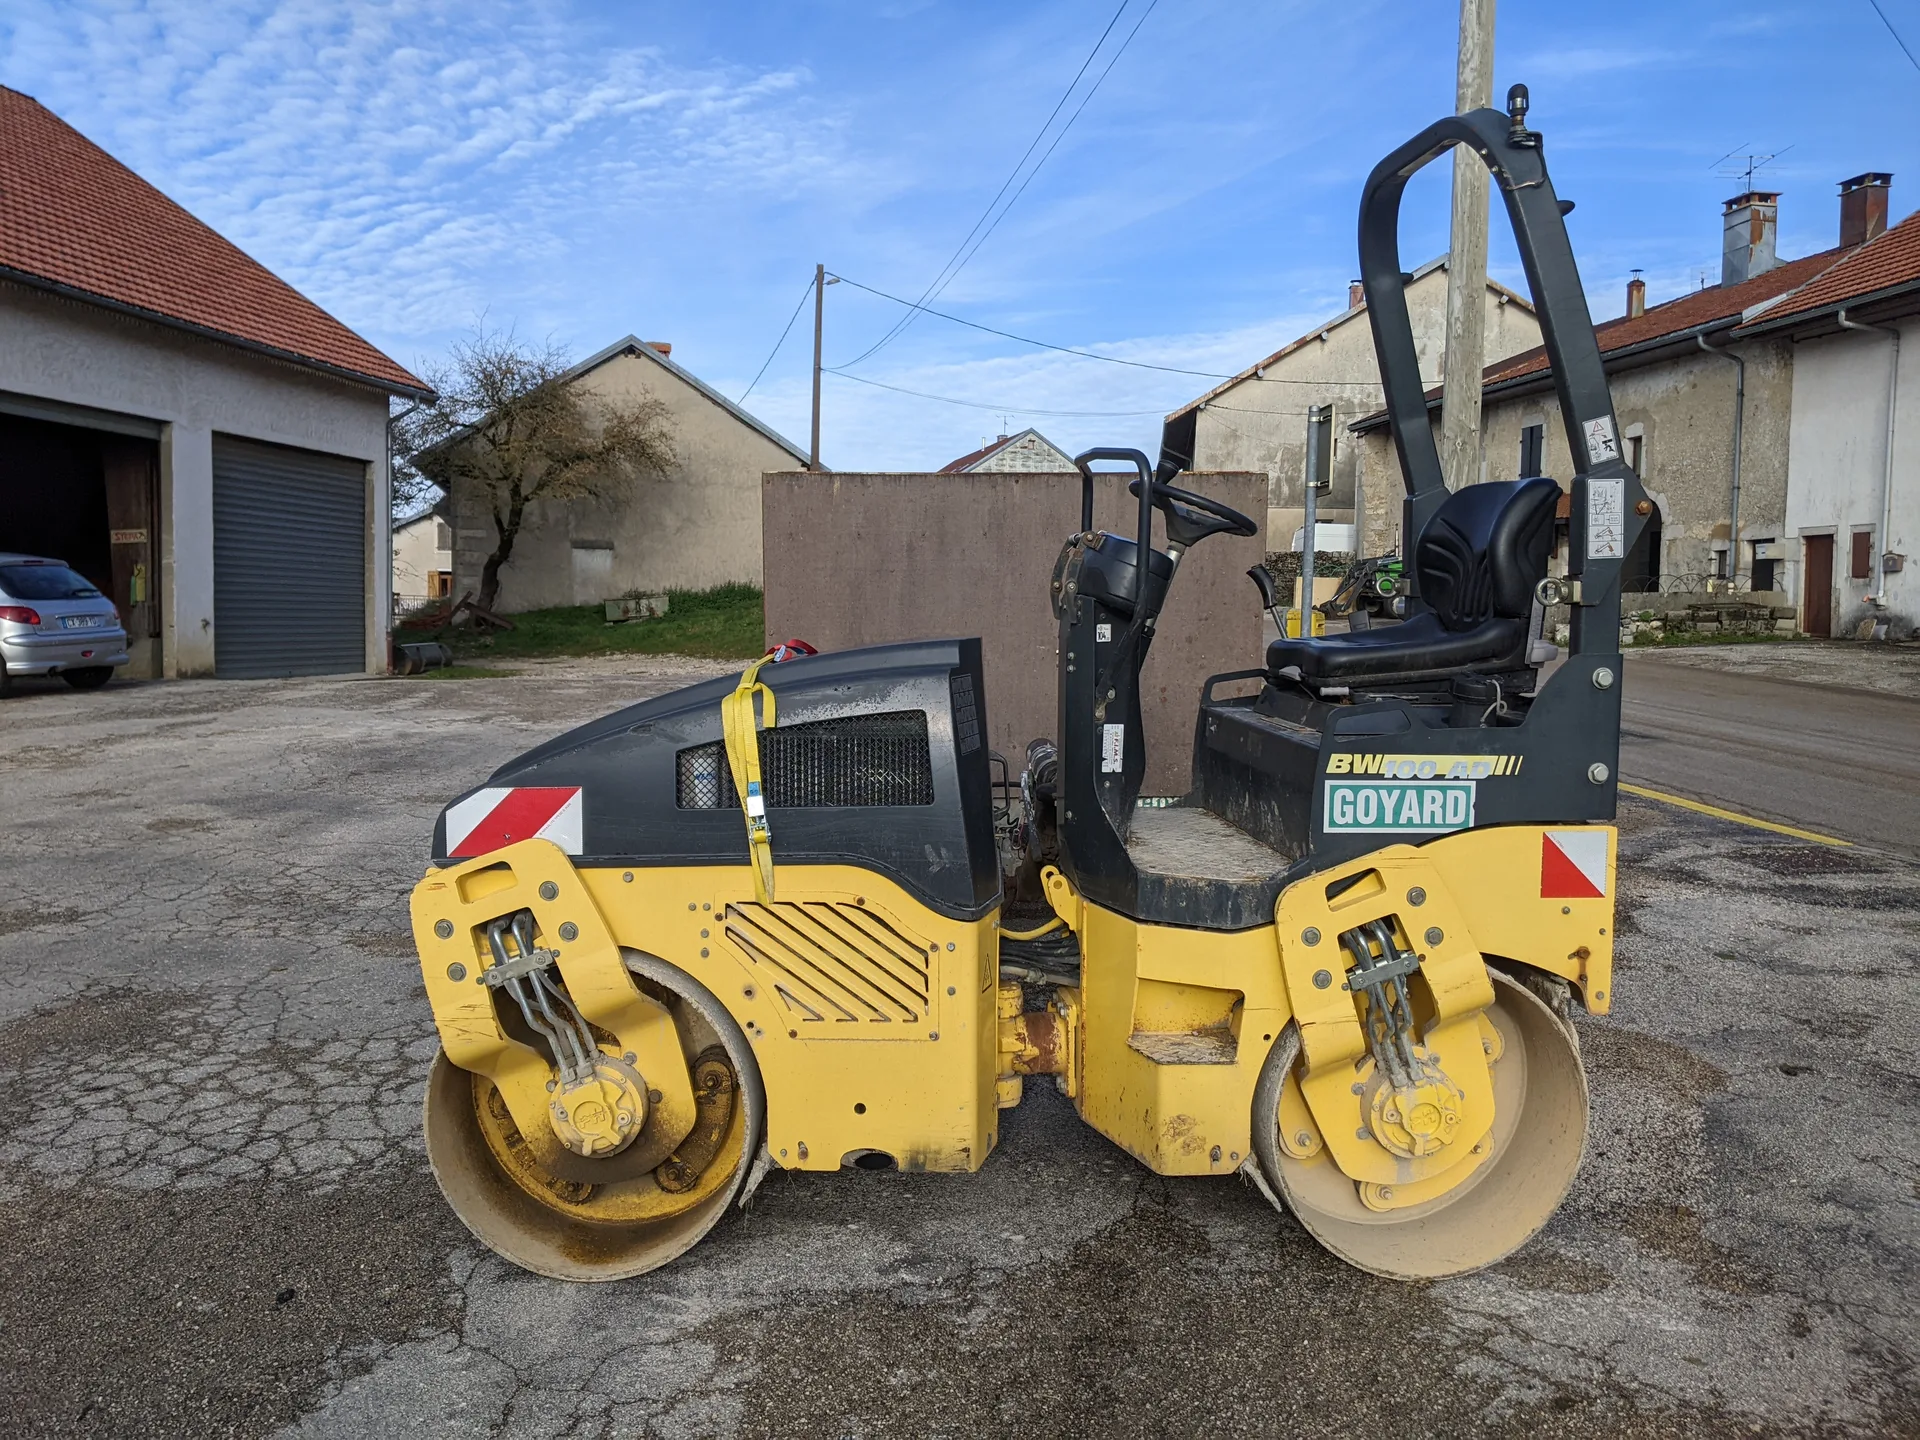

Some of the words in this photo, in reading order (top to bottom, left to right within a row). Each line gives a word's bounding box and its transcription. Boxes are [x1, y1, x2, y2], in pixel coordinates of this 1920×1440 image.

[1326, 753, 1382, 774] BW
[1444, 760, 1492, 779] AD
[1333, 788, 1467, 825] GOYARD
